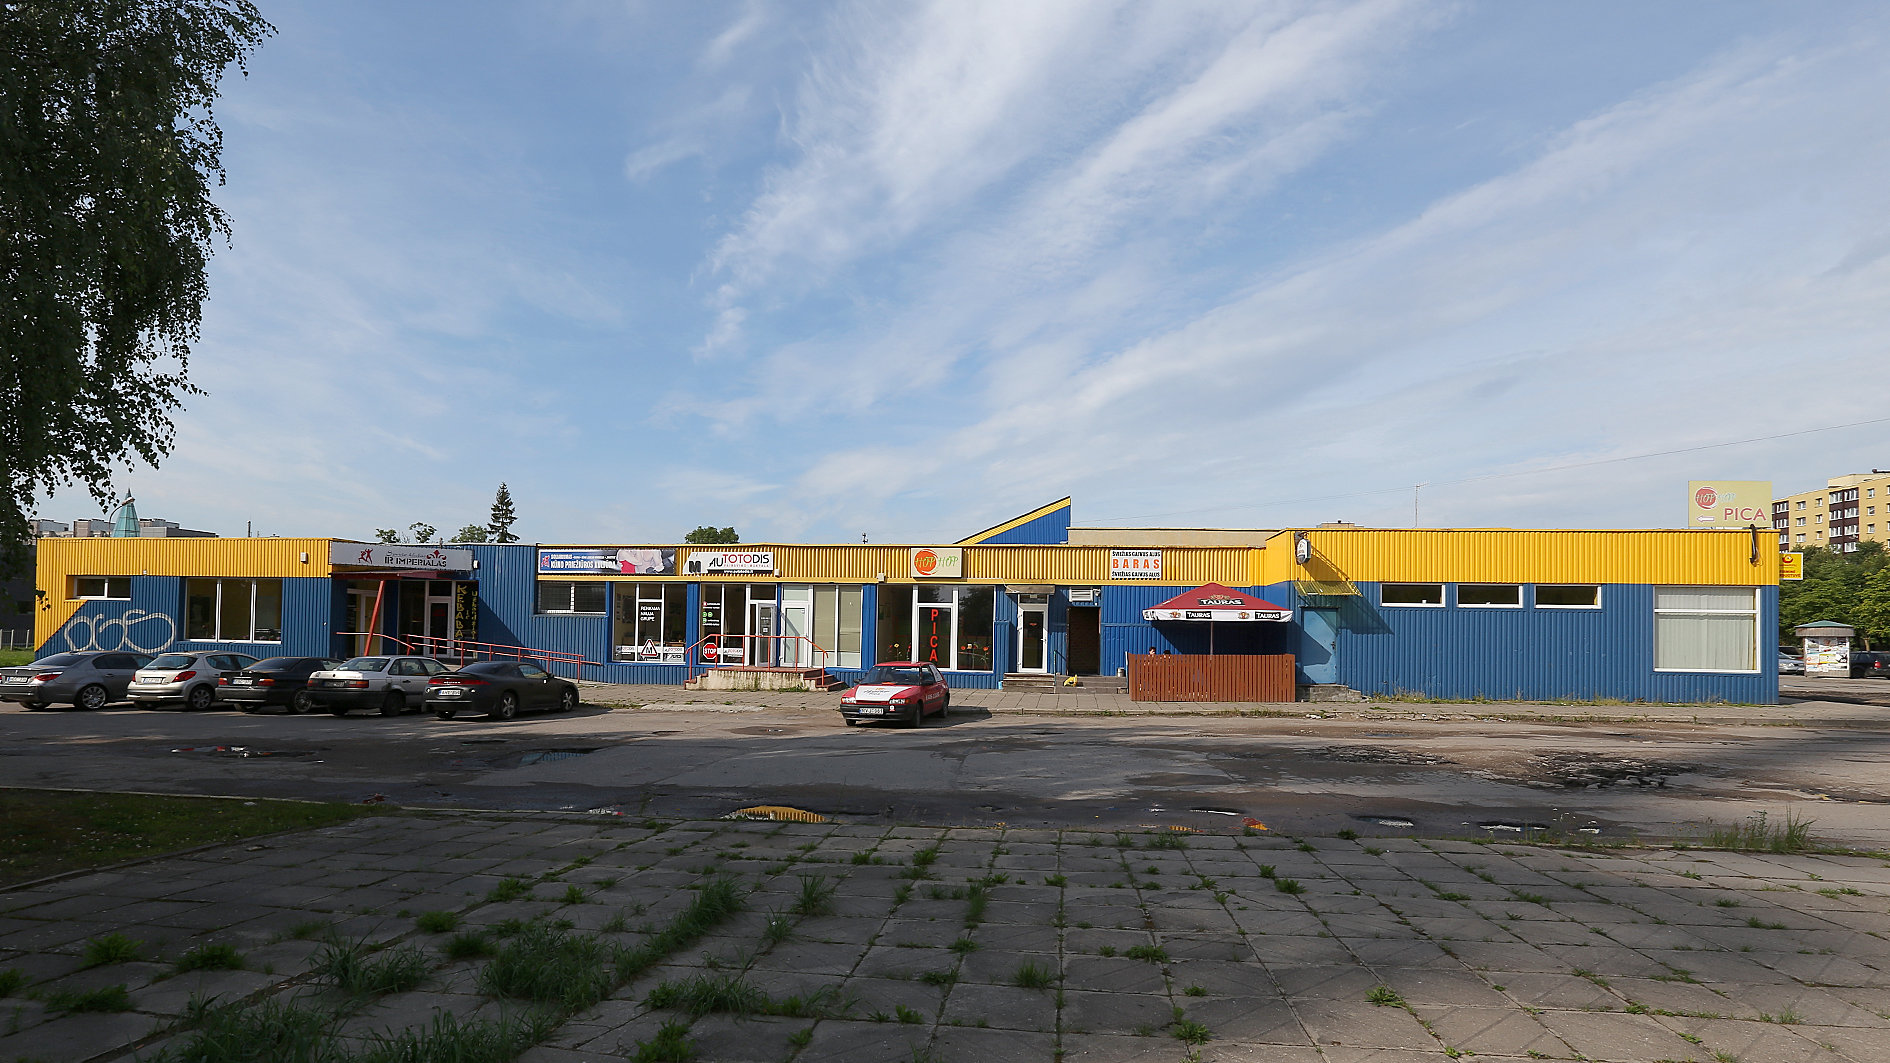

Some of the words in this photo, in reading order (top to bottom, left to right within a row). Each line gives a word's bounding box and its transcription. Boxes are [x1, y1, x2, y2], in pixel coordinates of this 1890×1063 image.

[1724, 508, 1766, 520] PICA
[395, 557, 447, 568] IMPERIALAS
[688, 560, 701, 573] M
[709, 554, 770, 567] AUTOTODIS
[914, 556, 936, 568] HOP
[938, 556, 959, 568] HOP
[1112, 558, 1160, 569] BARAS
[1187, 611, 1211, 619] TAURAS
[1255, 612, 1280, 620] TAURAS
[929, 608, 939, 662] PICA
